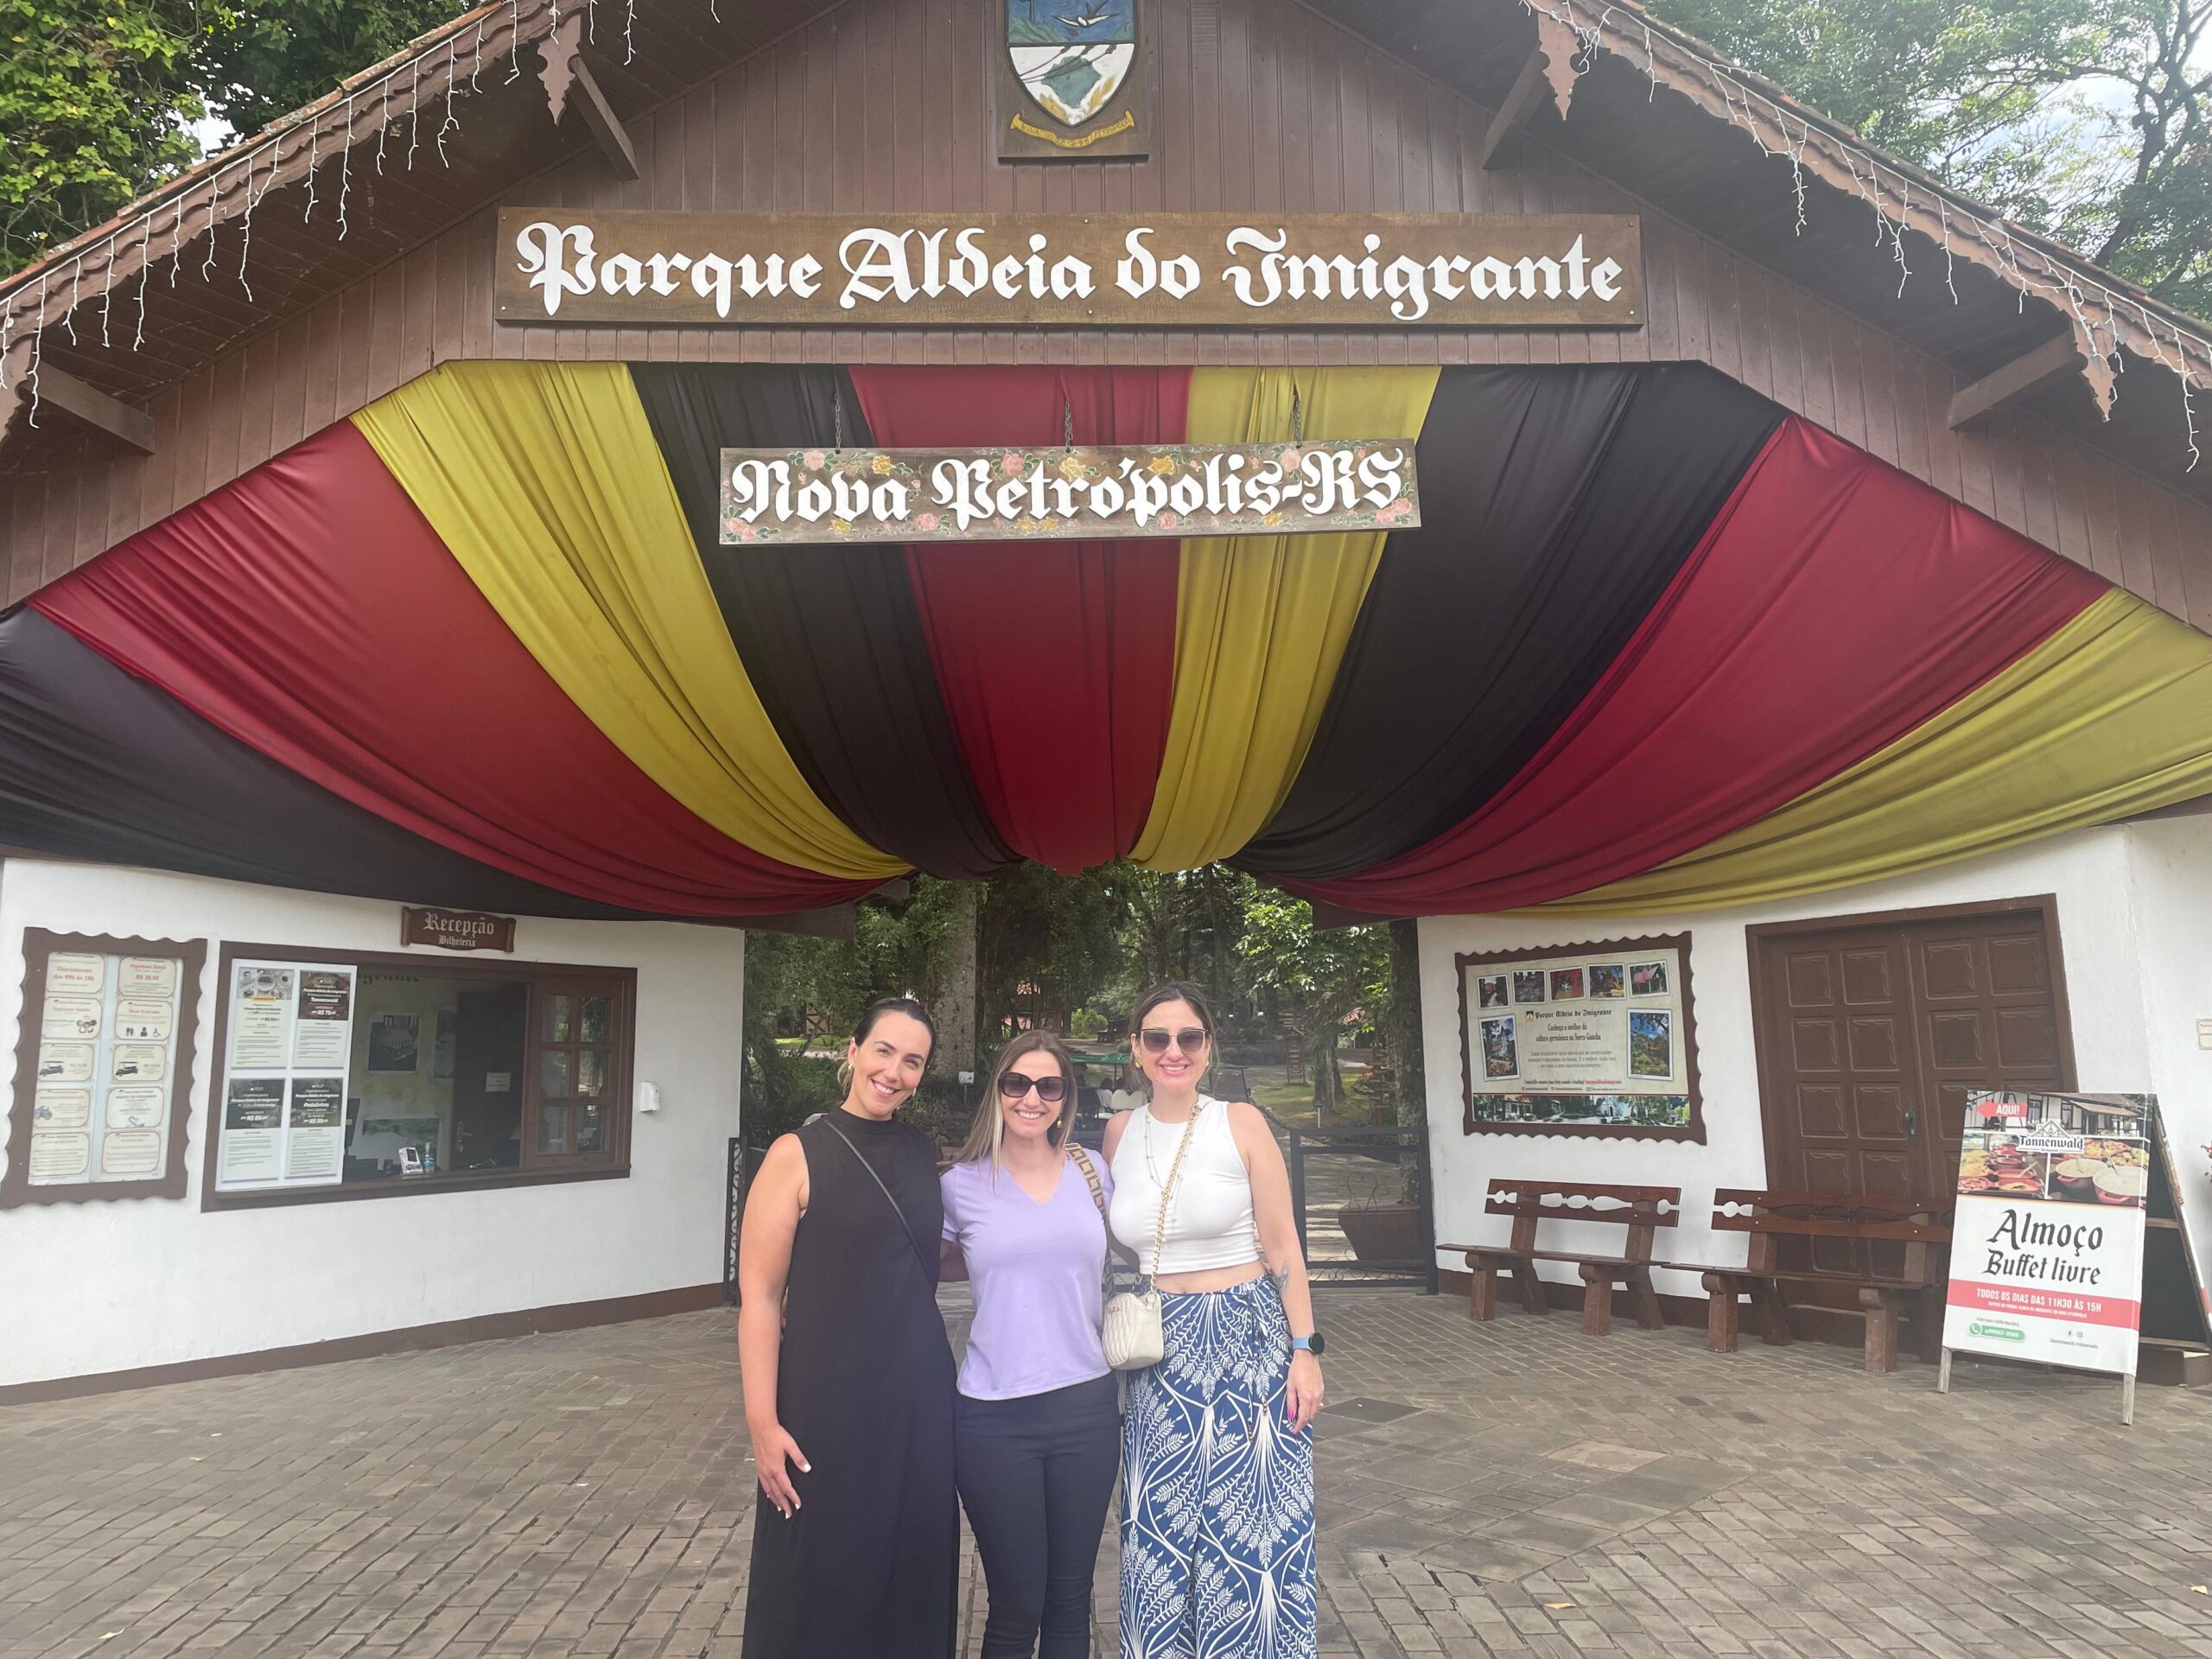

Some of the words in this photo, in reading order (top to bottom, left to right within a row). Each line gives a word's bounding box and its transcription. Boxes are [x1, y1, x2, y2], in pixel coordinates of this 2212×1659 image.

[516, 221, 824, 319] Parque
[838, 227, 1096, 310] Aldeia
[1115, 227, 1201, 300] do
[1221, 226, 1624, 321] Imigrante
[731, 459, 912, 524] Nova
[423, 912, 495, 938] Recepção
[438, 934, 476, 947] Bilheteria
[1535, 1011, 1554, 1020] Parque
[1582, 1009, 1612, 1018] Imigrante
[1996, 1104, 2020, 1116] AQUI!
[2018, 1135, 2083, 1150] Tannenwald
[1986, 1209, 2103, 1257] Almoço
[1980, 1248, 2048, 1280] Buffet
[2050, 1256, 2101, 1285] livre
[1977, 1287, 1999, 1300] TODOS
[2001, 1291, 2011, 1301] OS
[2012, 1293, 2029, 1303] DIAS
[2031, 1294, 2045, 1306] DAS
[2048, 1297, 2072, 1309] 11H30
[2074, 1299, 2084, 1310] ÀS
[2087, 1301, 2101, 1313] 15H
